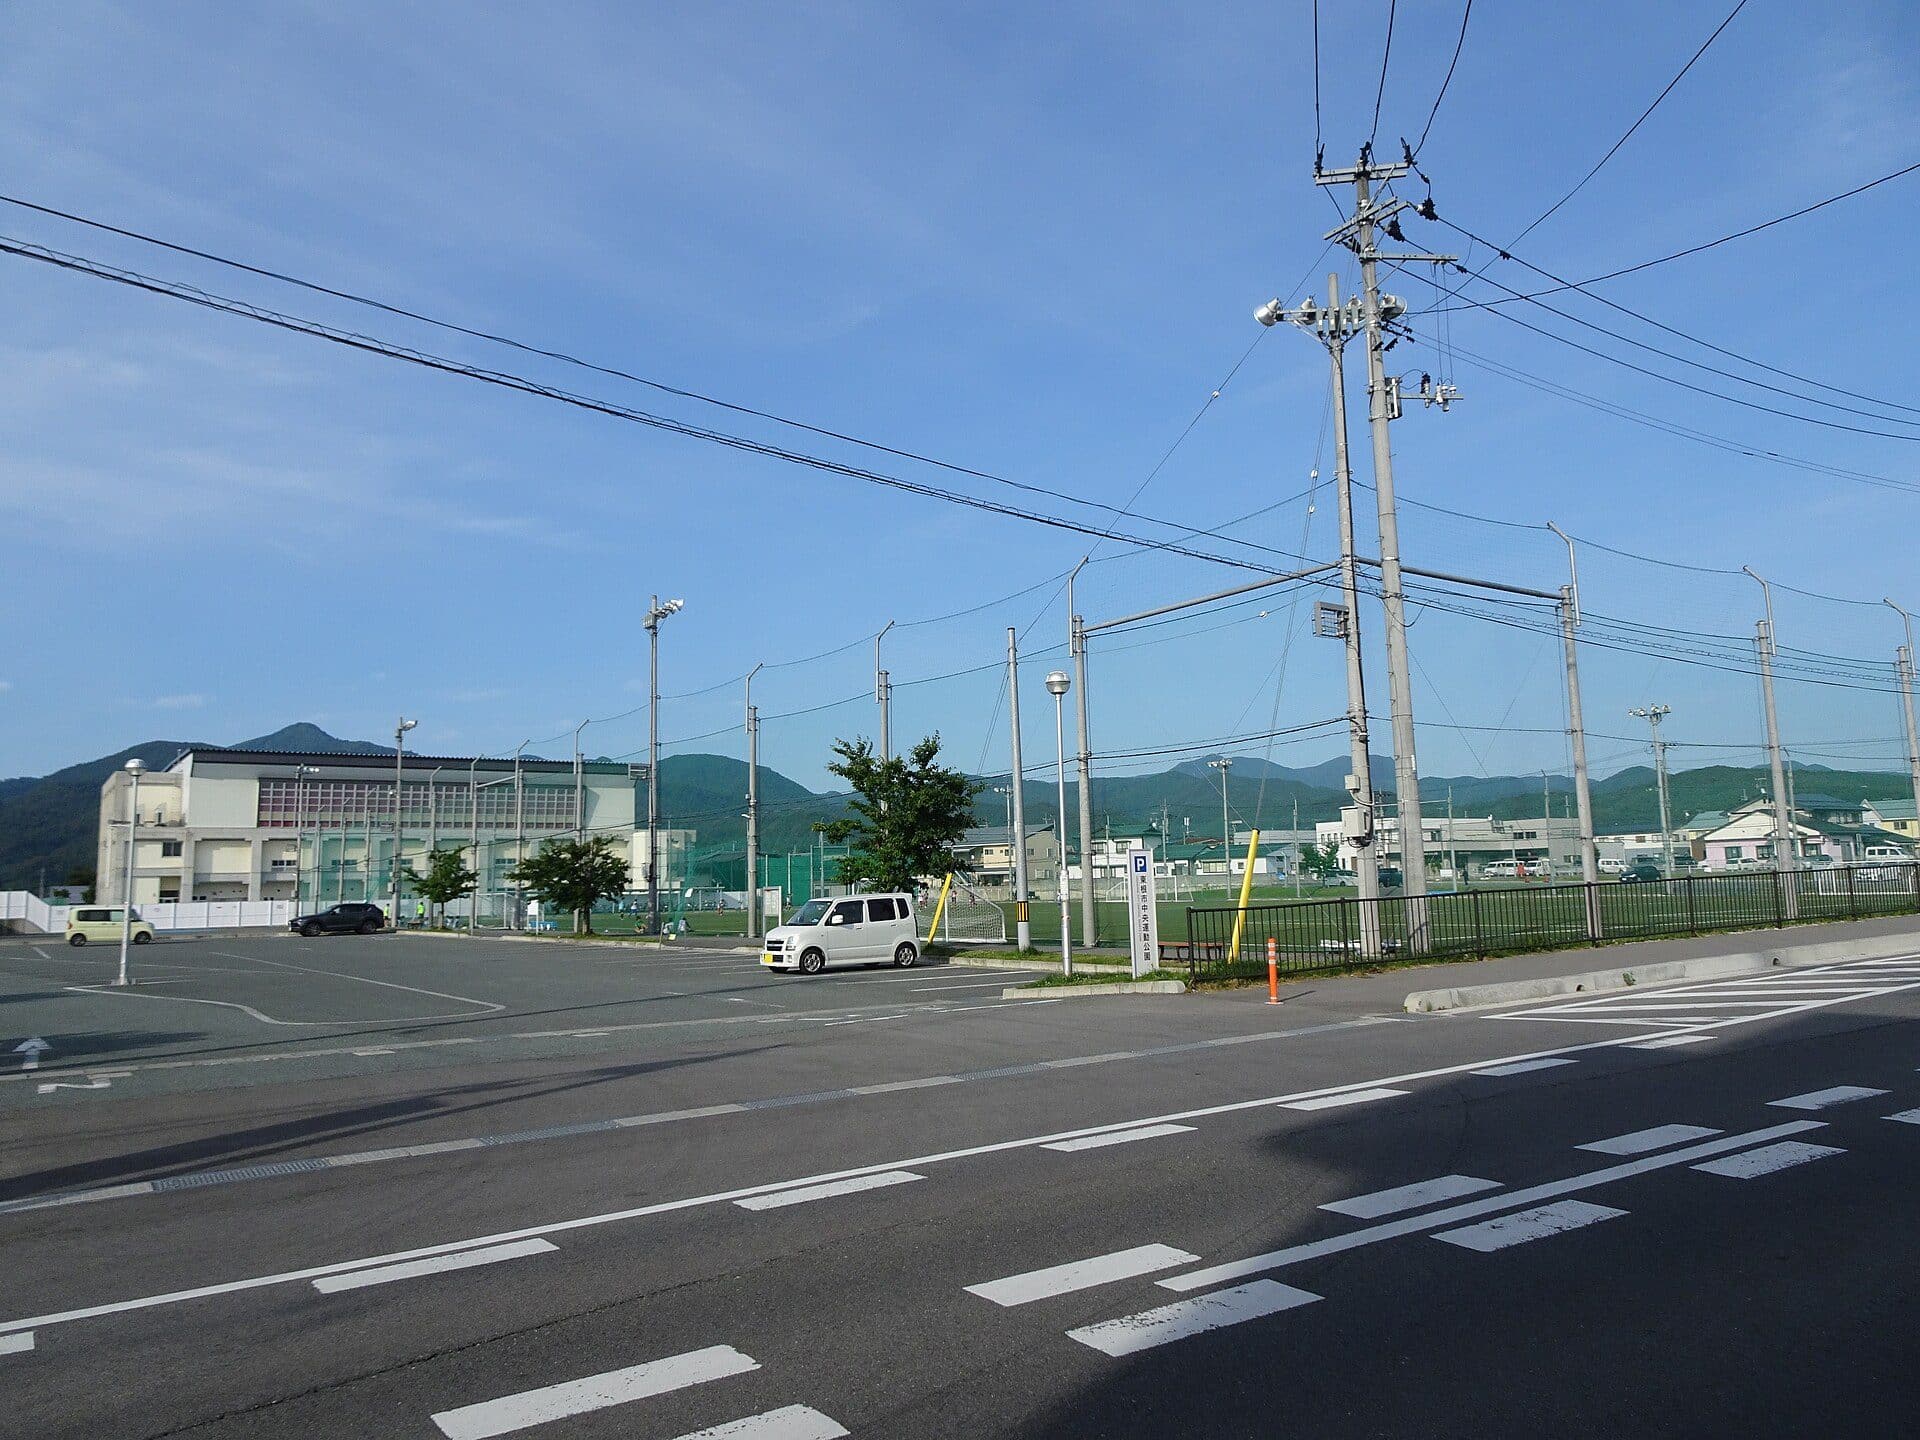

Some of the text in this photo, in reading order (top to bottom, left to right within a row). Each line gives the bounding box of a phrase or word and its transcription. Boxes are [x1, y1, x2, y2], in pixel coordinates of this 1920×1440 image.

[1136, 858, 1145, 871] P
[1140, 875, 1151, 961] 東根市中央運動公園
